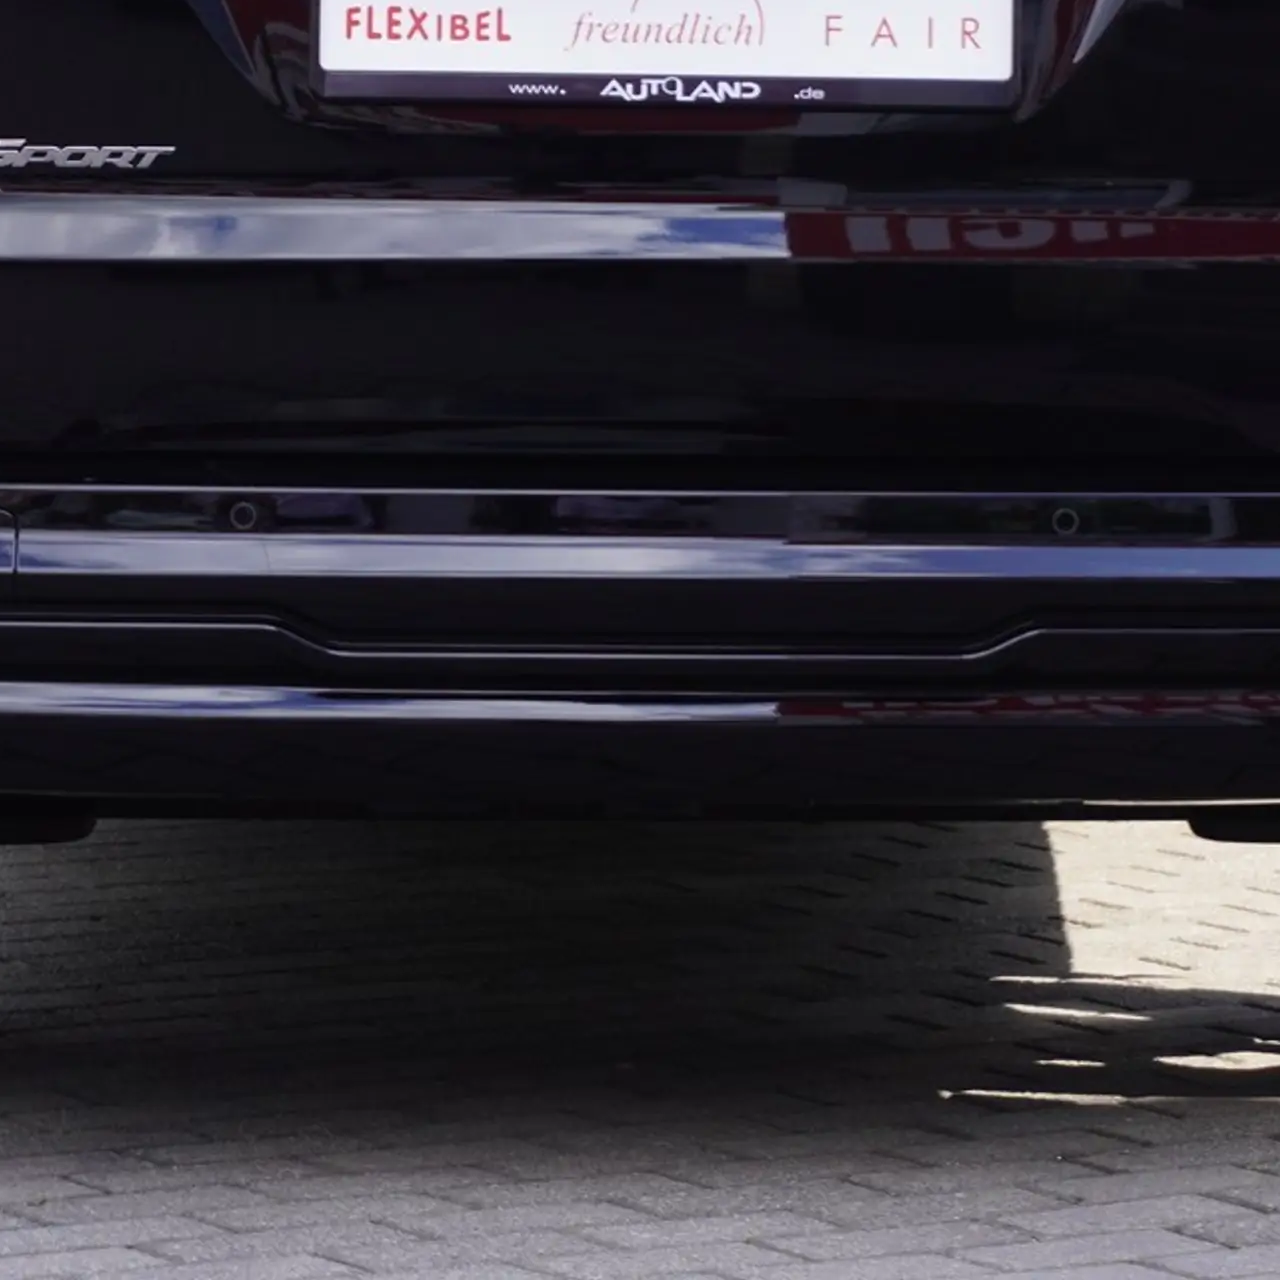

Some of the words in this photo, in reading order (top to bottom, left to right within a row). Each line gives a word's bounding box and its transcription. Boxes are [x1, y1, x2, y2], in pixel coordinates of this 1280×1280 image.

[345, 5, 512, 42] FLEXIBEL
[563, 11, 754, 52] freundlich
[824, 15, 982, 49] FAIR
[508, 83, 567, 96] www.
[599, 76, 762, 102] AUTOLAND
[793, 86, 826, 100] .de
